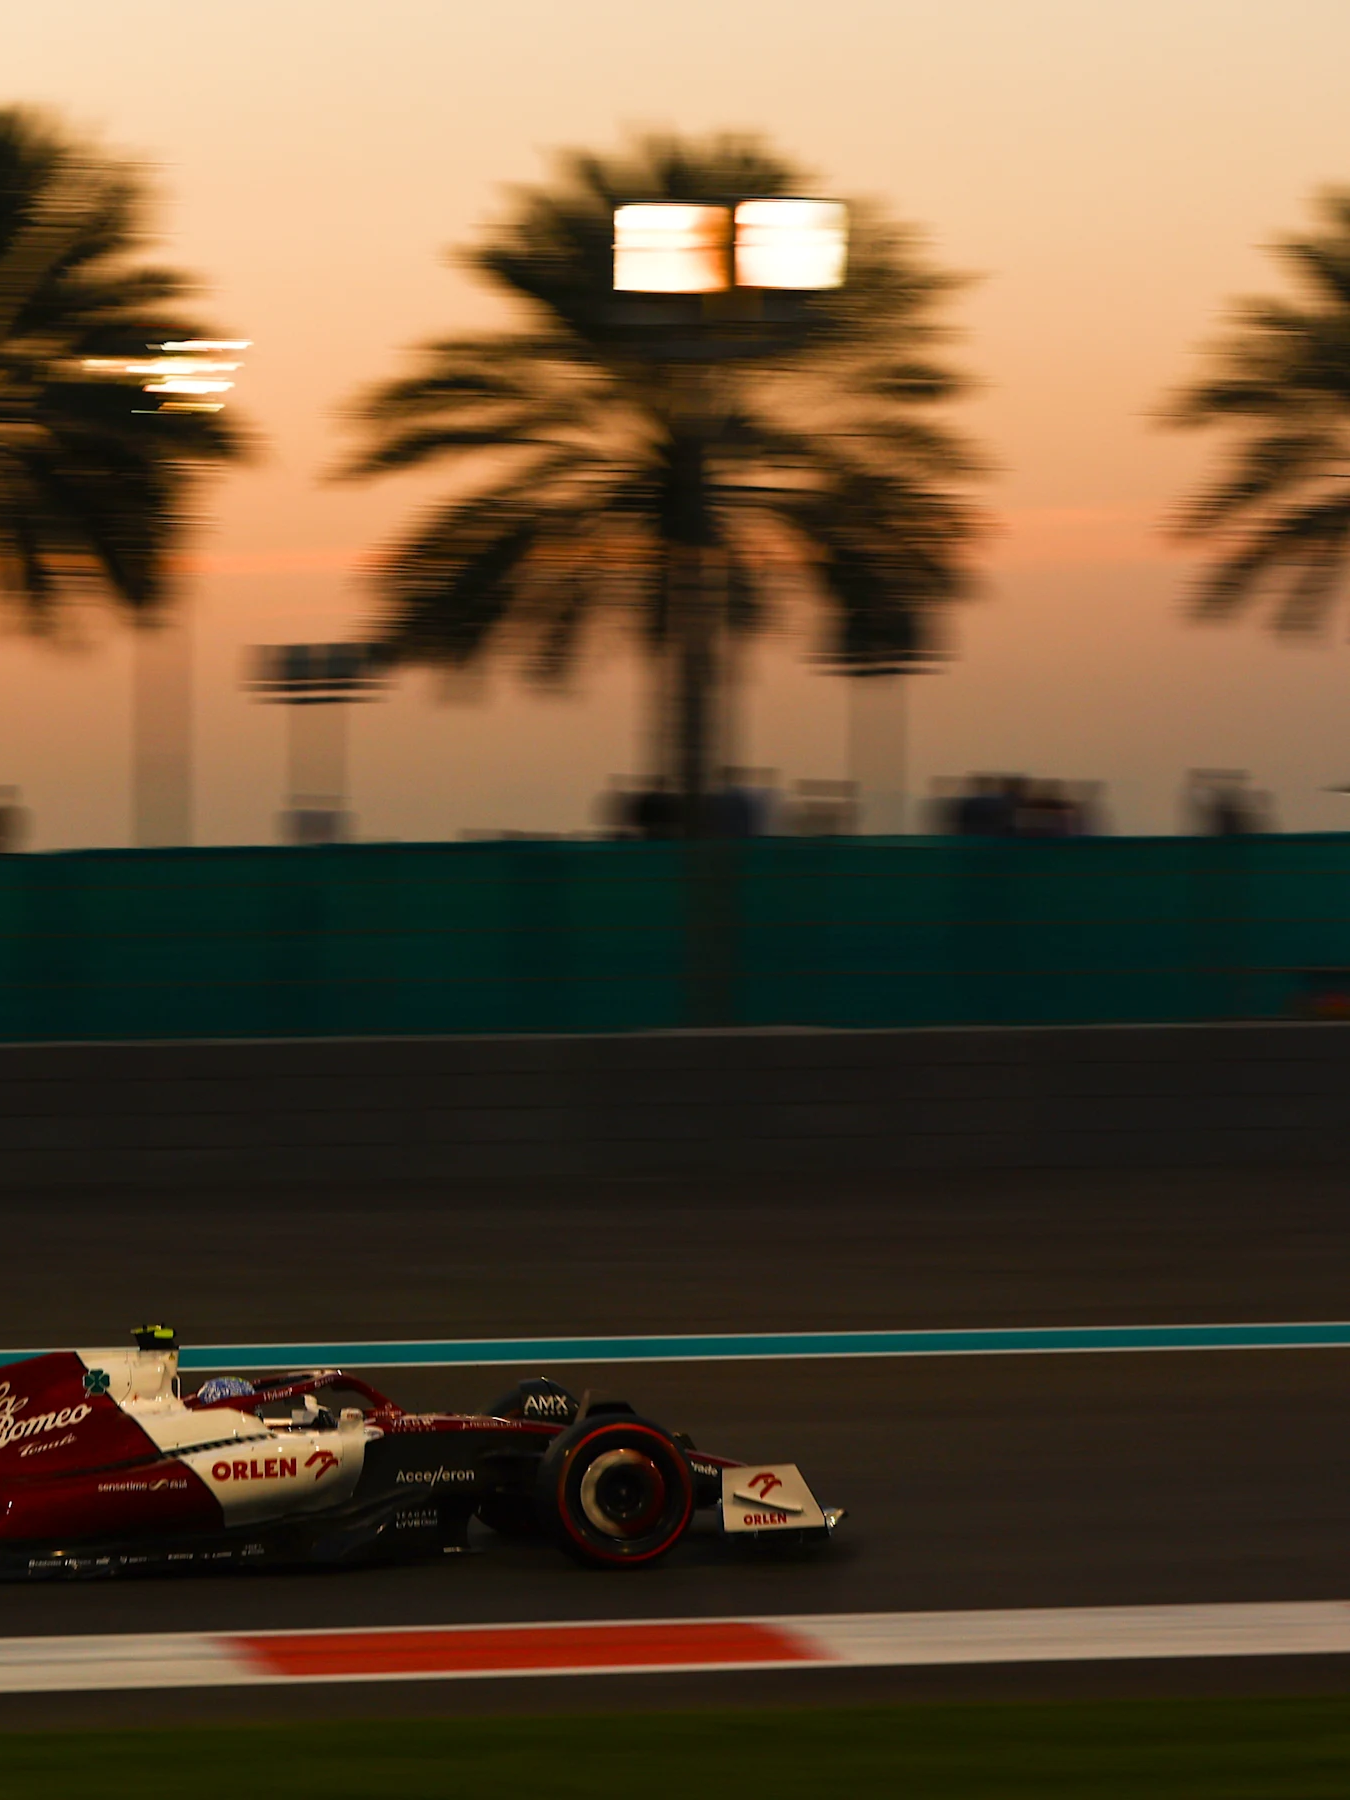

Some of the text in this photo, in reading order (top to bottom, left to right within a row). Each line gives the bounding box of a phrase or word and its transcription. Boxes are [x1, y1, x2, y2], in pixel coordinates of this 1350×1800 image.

[523, 1394, 569, 1413] AMX
[212, 1458, 297, 1481] ORLEN
[98, 1480, 147, 1492] sensetime
[743, 1512, 787, 1525] ORLEN
